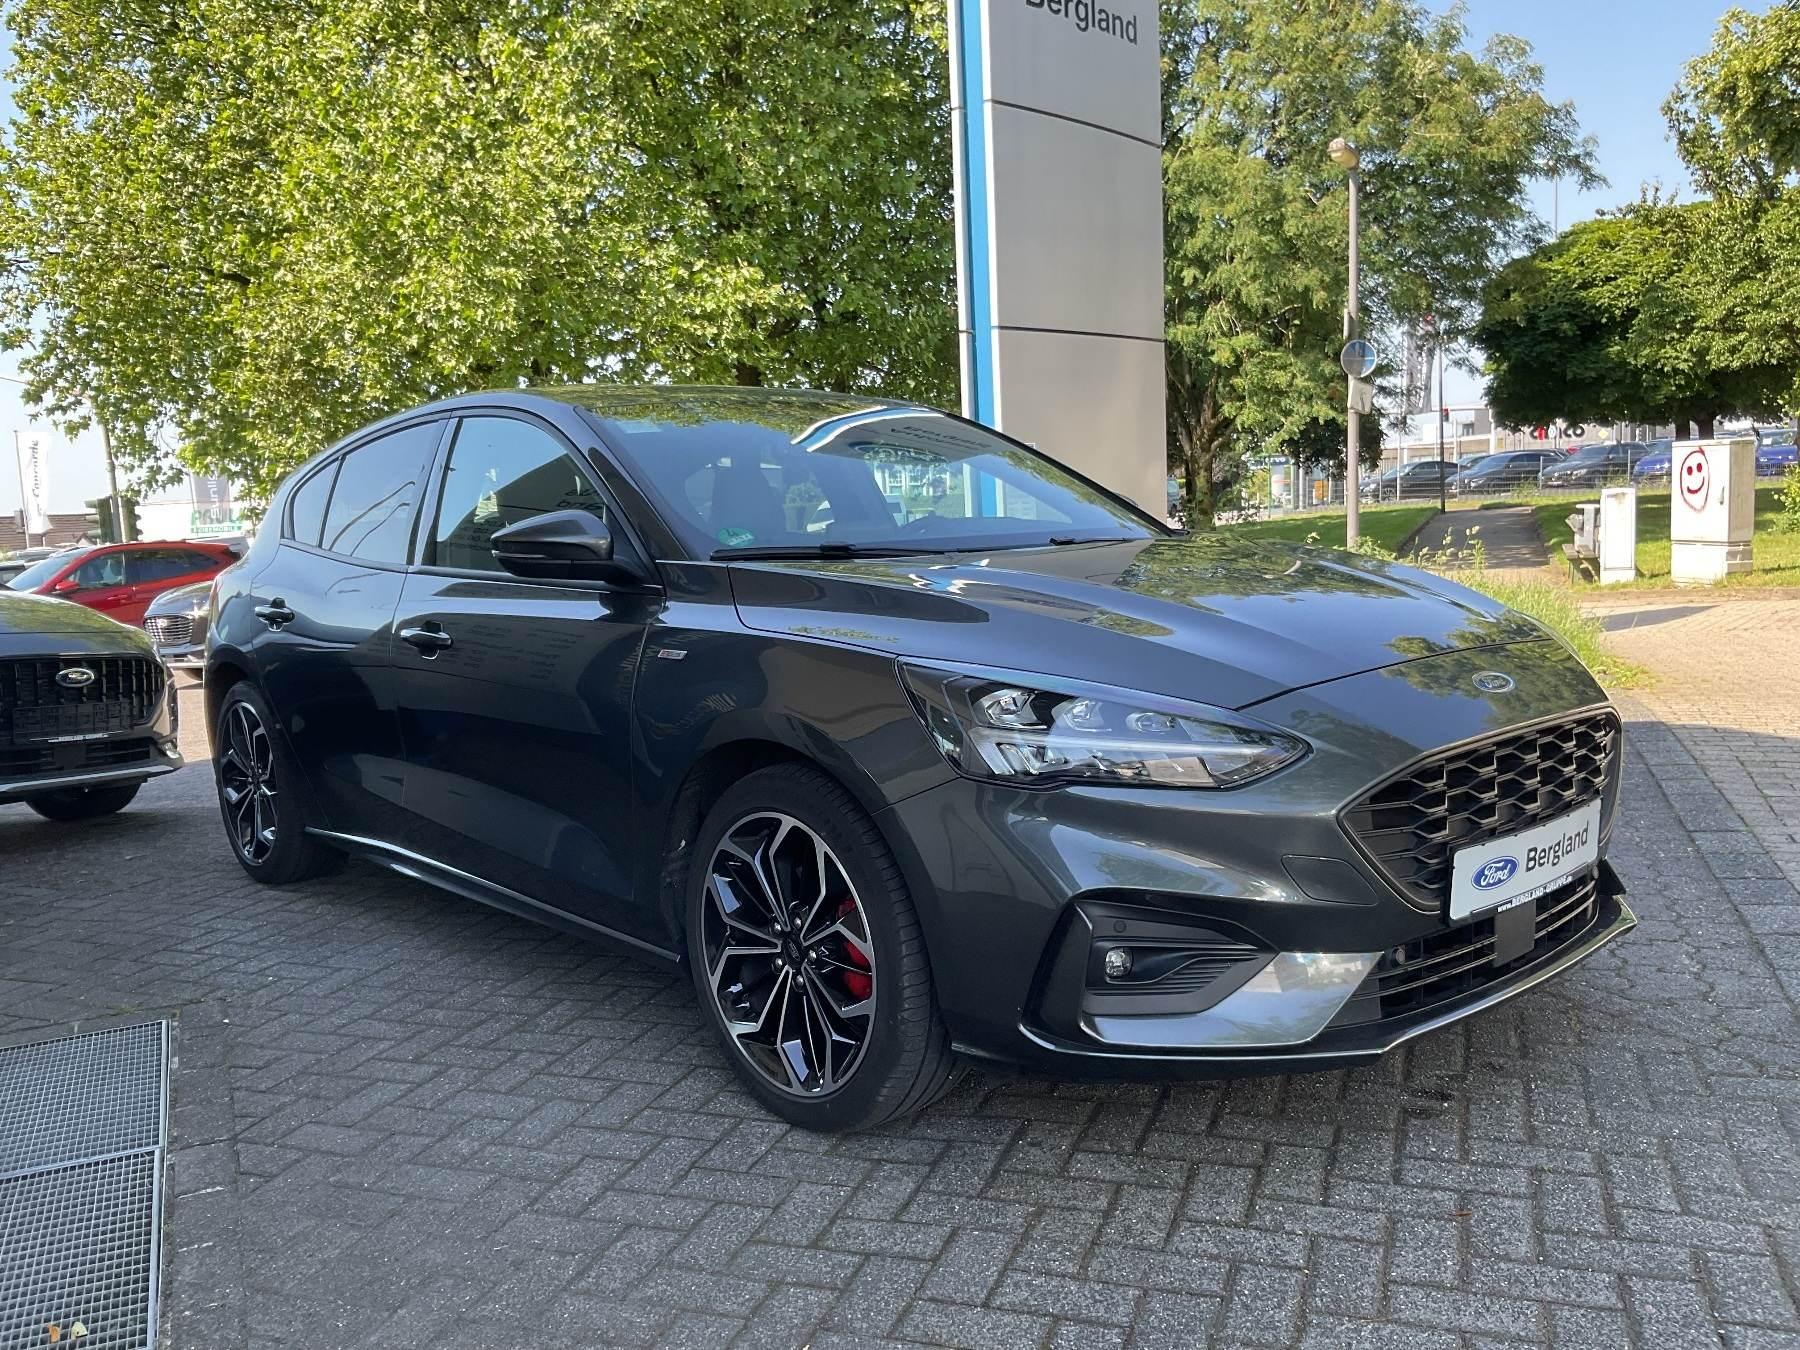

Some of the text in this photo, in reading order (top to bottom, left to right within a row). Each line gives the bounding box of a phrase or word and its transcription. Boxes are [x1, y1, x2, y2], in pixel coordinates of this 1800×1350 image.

[1025, 0, 1138, 45] ergland
[1481, 821, 1589, 886] Ford Bergland
